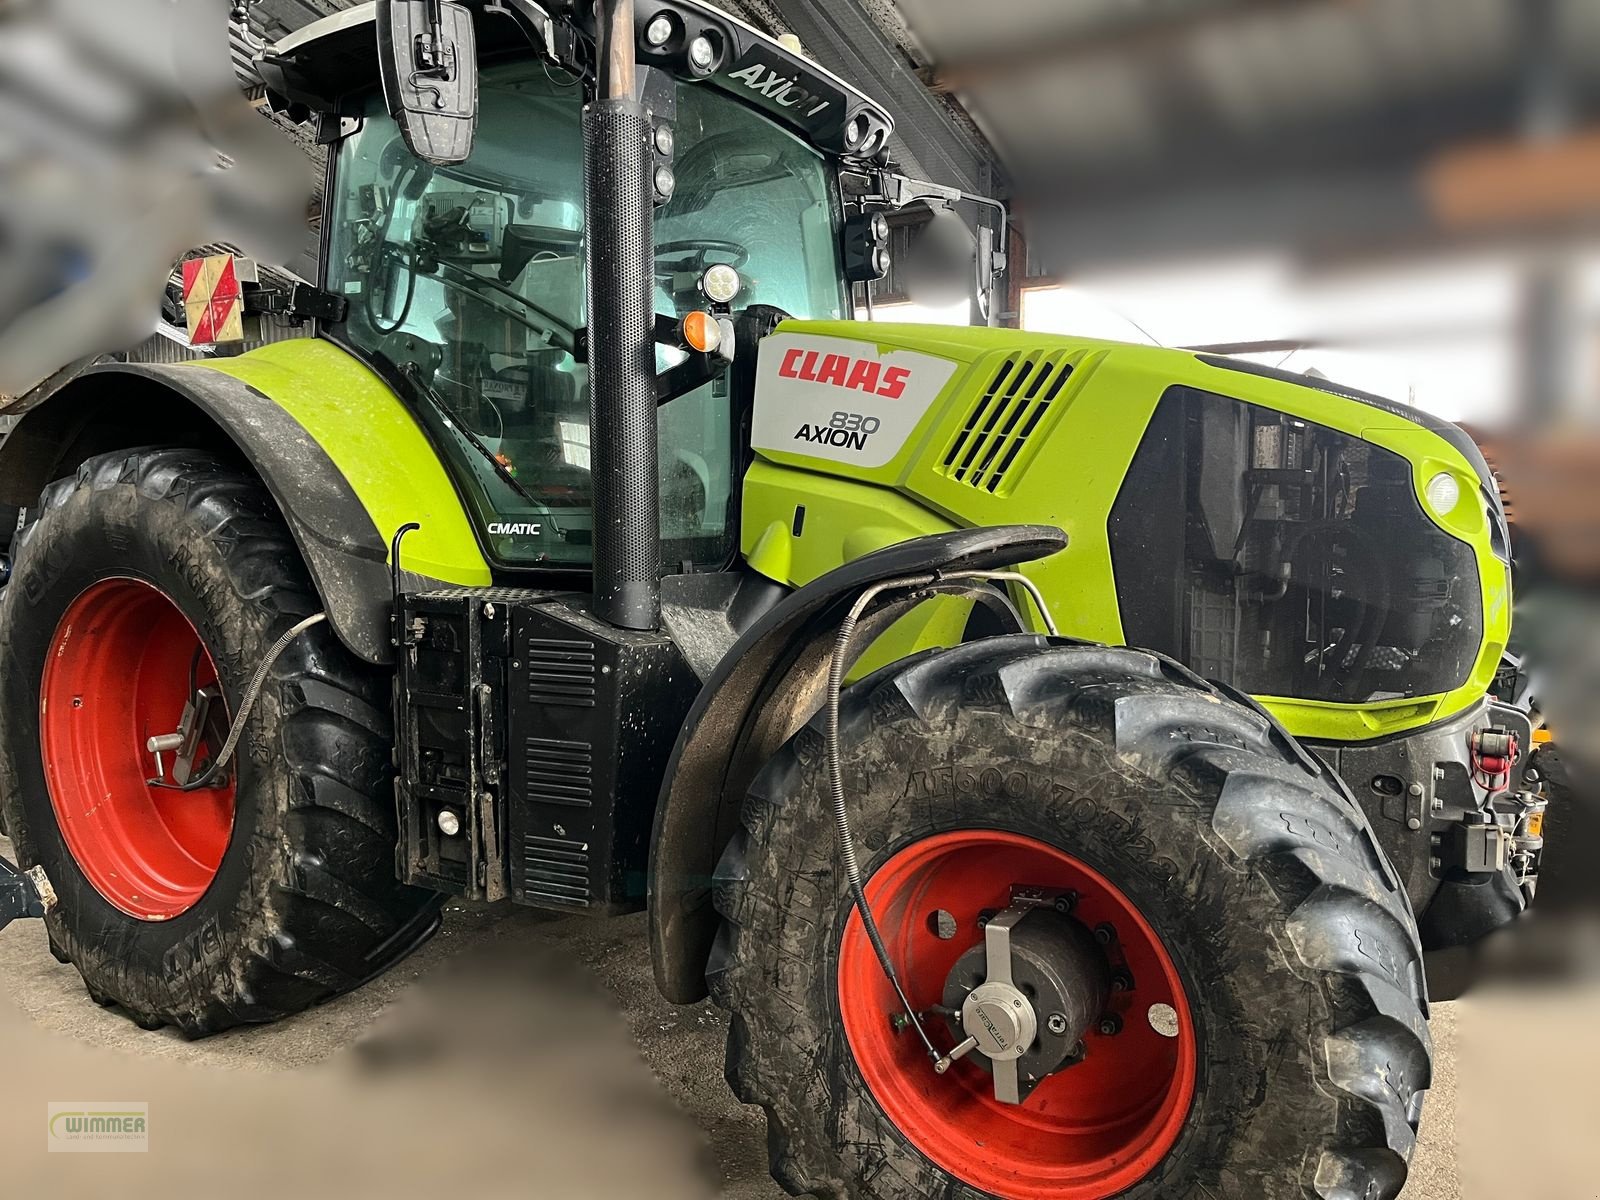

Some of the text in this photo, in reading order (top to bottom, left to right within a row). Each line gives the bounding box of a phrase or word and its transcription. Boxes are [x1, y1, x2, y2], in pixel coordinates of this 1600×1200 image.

[728, 63, 830, 117] AXION
[778, 348, 912, 400] CLAAS
[829, 411, 881, 434] 830
[794, 423, 868, 451] AXION
[487, 522, 541, 535] CMATIC
